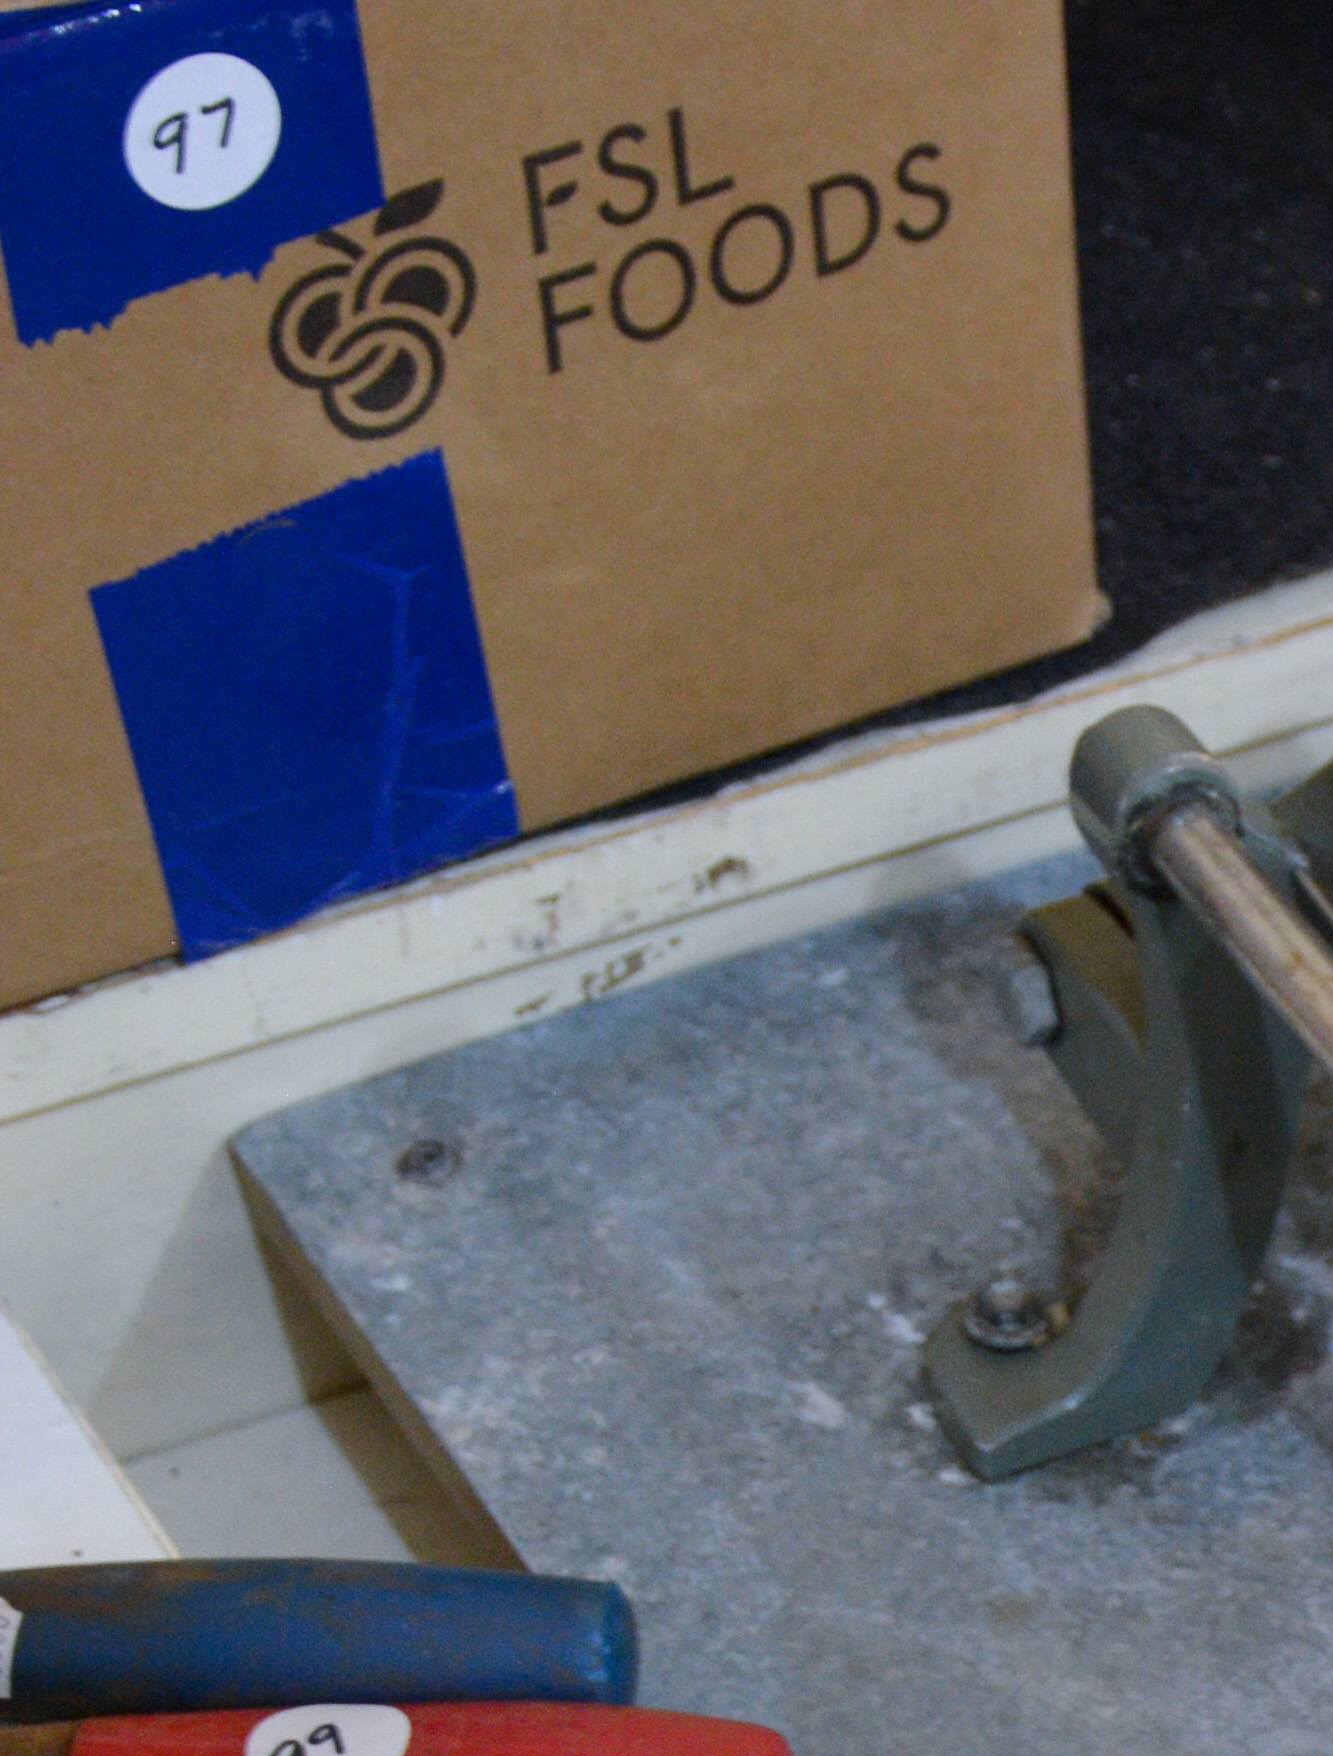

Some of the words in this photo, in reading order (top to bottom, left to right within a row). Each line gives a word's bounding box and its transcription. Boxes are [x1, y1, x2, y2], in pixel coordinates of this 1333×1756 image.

[151, 97, 238, 175] 97
[521, 106, 737, 256] FSL
[536, 142, 953, 375] FOODS
